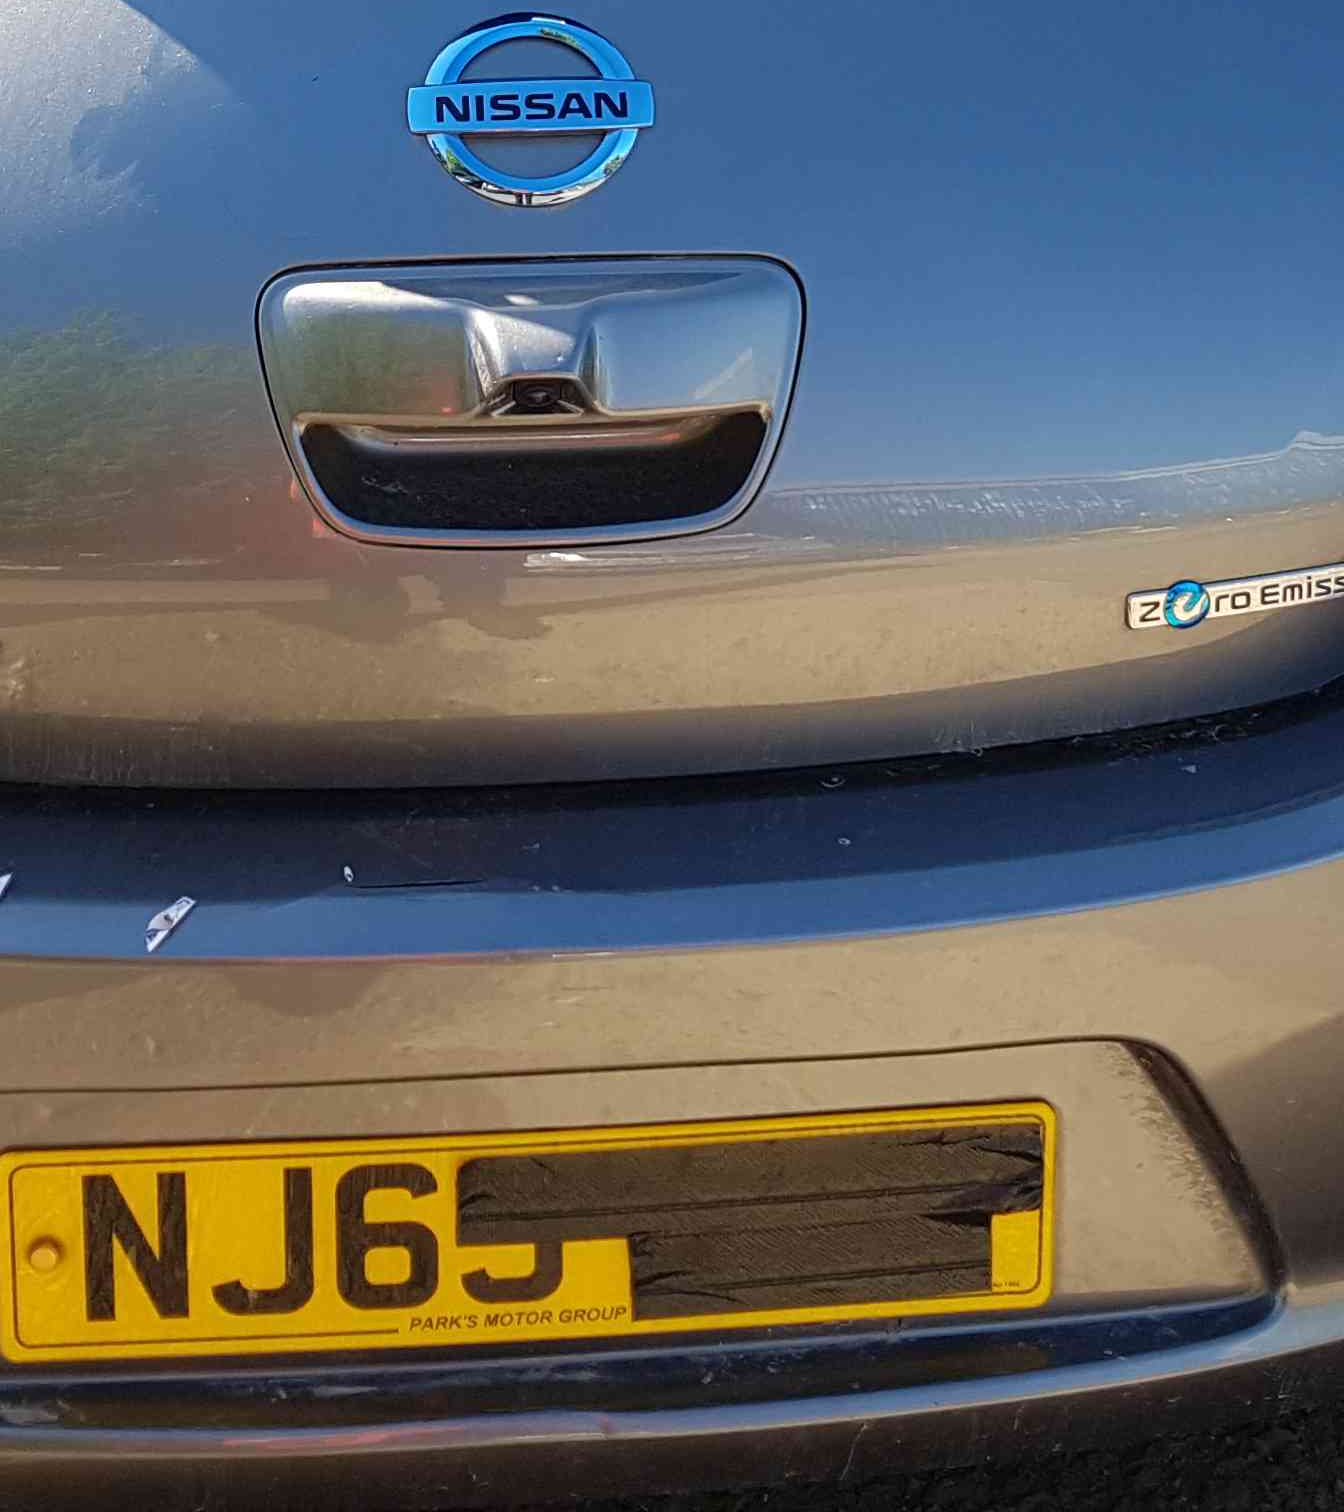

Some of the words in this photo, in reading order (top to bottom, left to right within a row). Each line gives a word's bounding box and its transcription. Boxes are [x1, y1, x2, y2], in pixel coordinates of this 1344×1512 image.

[435, 91, 629, 123] NISSAN
[409, 1315, 478, 1331] PARK'S
[484, 1311, 553, 1328] MOTOR
[558, 1306, 627, 1324] GROUP
